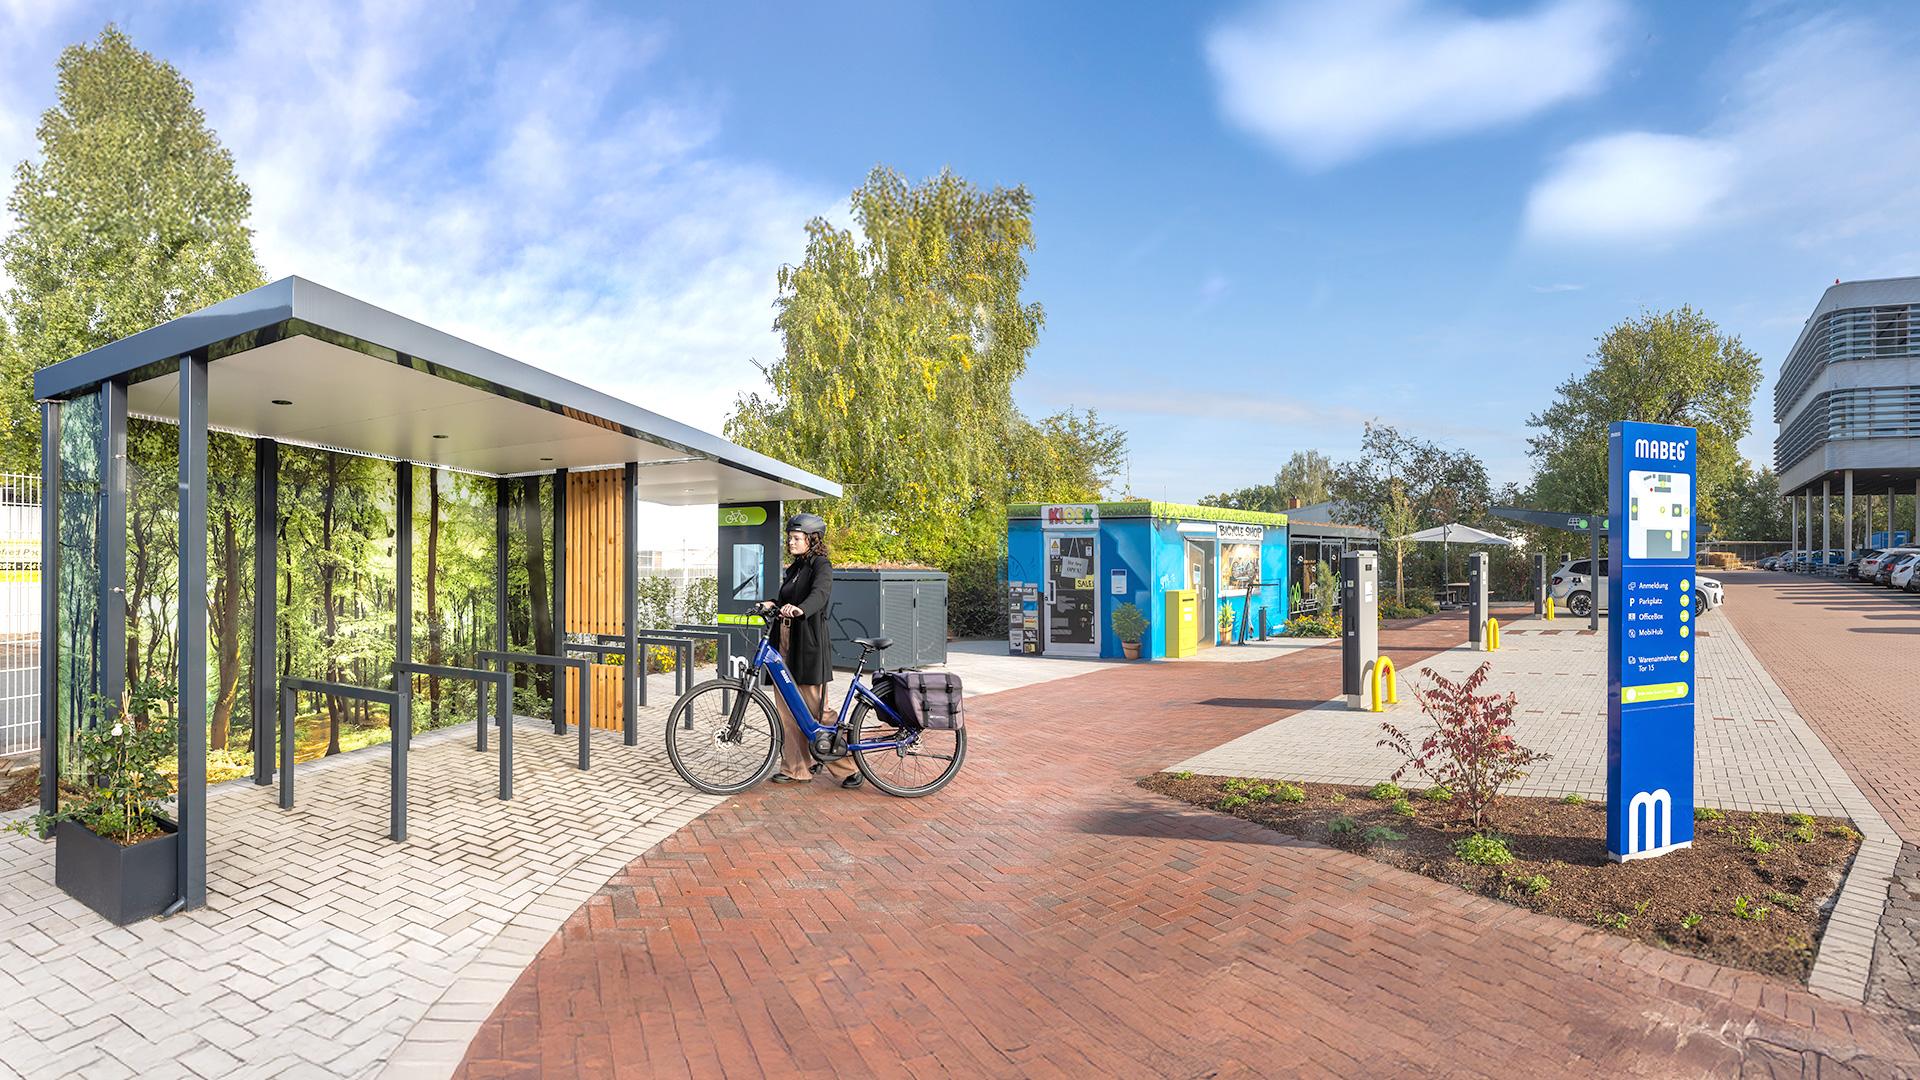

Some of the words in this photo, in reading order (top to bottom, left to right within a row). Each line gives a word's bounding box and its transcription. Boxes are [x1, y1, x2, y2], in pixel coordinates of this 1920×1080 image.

[1635, 439, 1688, 461] MABEG
[1049, 507, 1094, 525] KIOSK
[1219, 525, 1244, 537] BICYCLE
[1245, 526, 1262, 538] SHOP
[1638, 582, 1669, 591] Anmeldung
[1638, 597, 1663, 606] Parkplatz
[1638, 612, 1664, 621] OfficeBox
[1638, 628, 1664, 636] MobiHub
[1638, 654, 1678, 664] Warenannahme
[1638, 664, 1647, 672] Tor
[1647, 664, 1655, 672] 15
